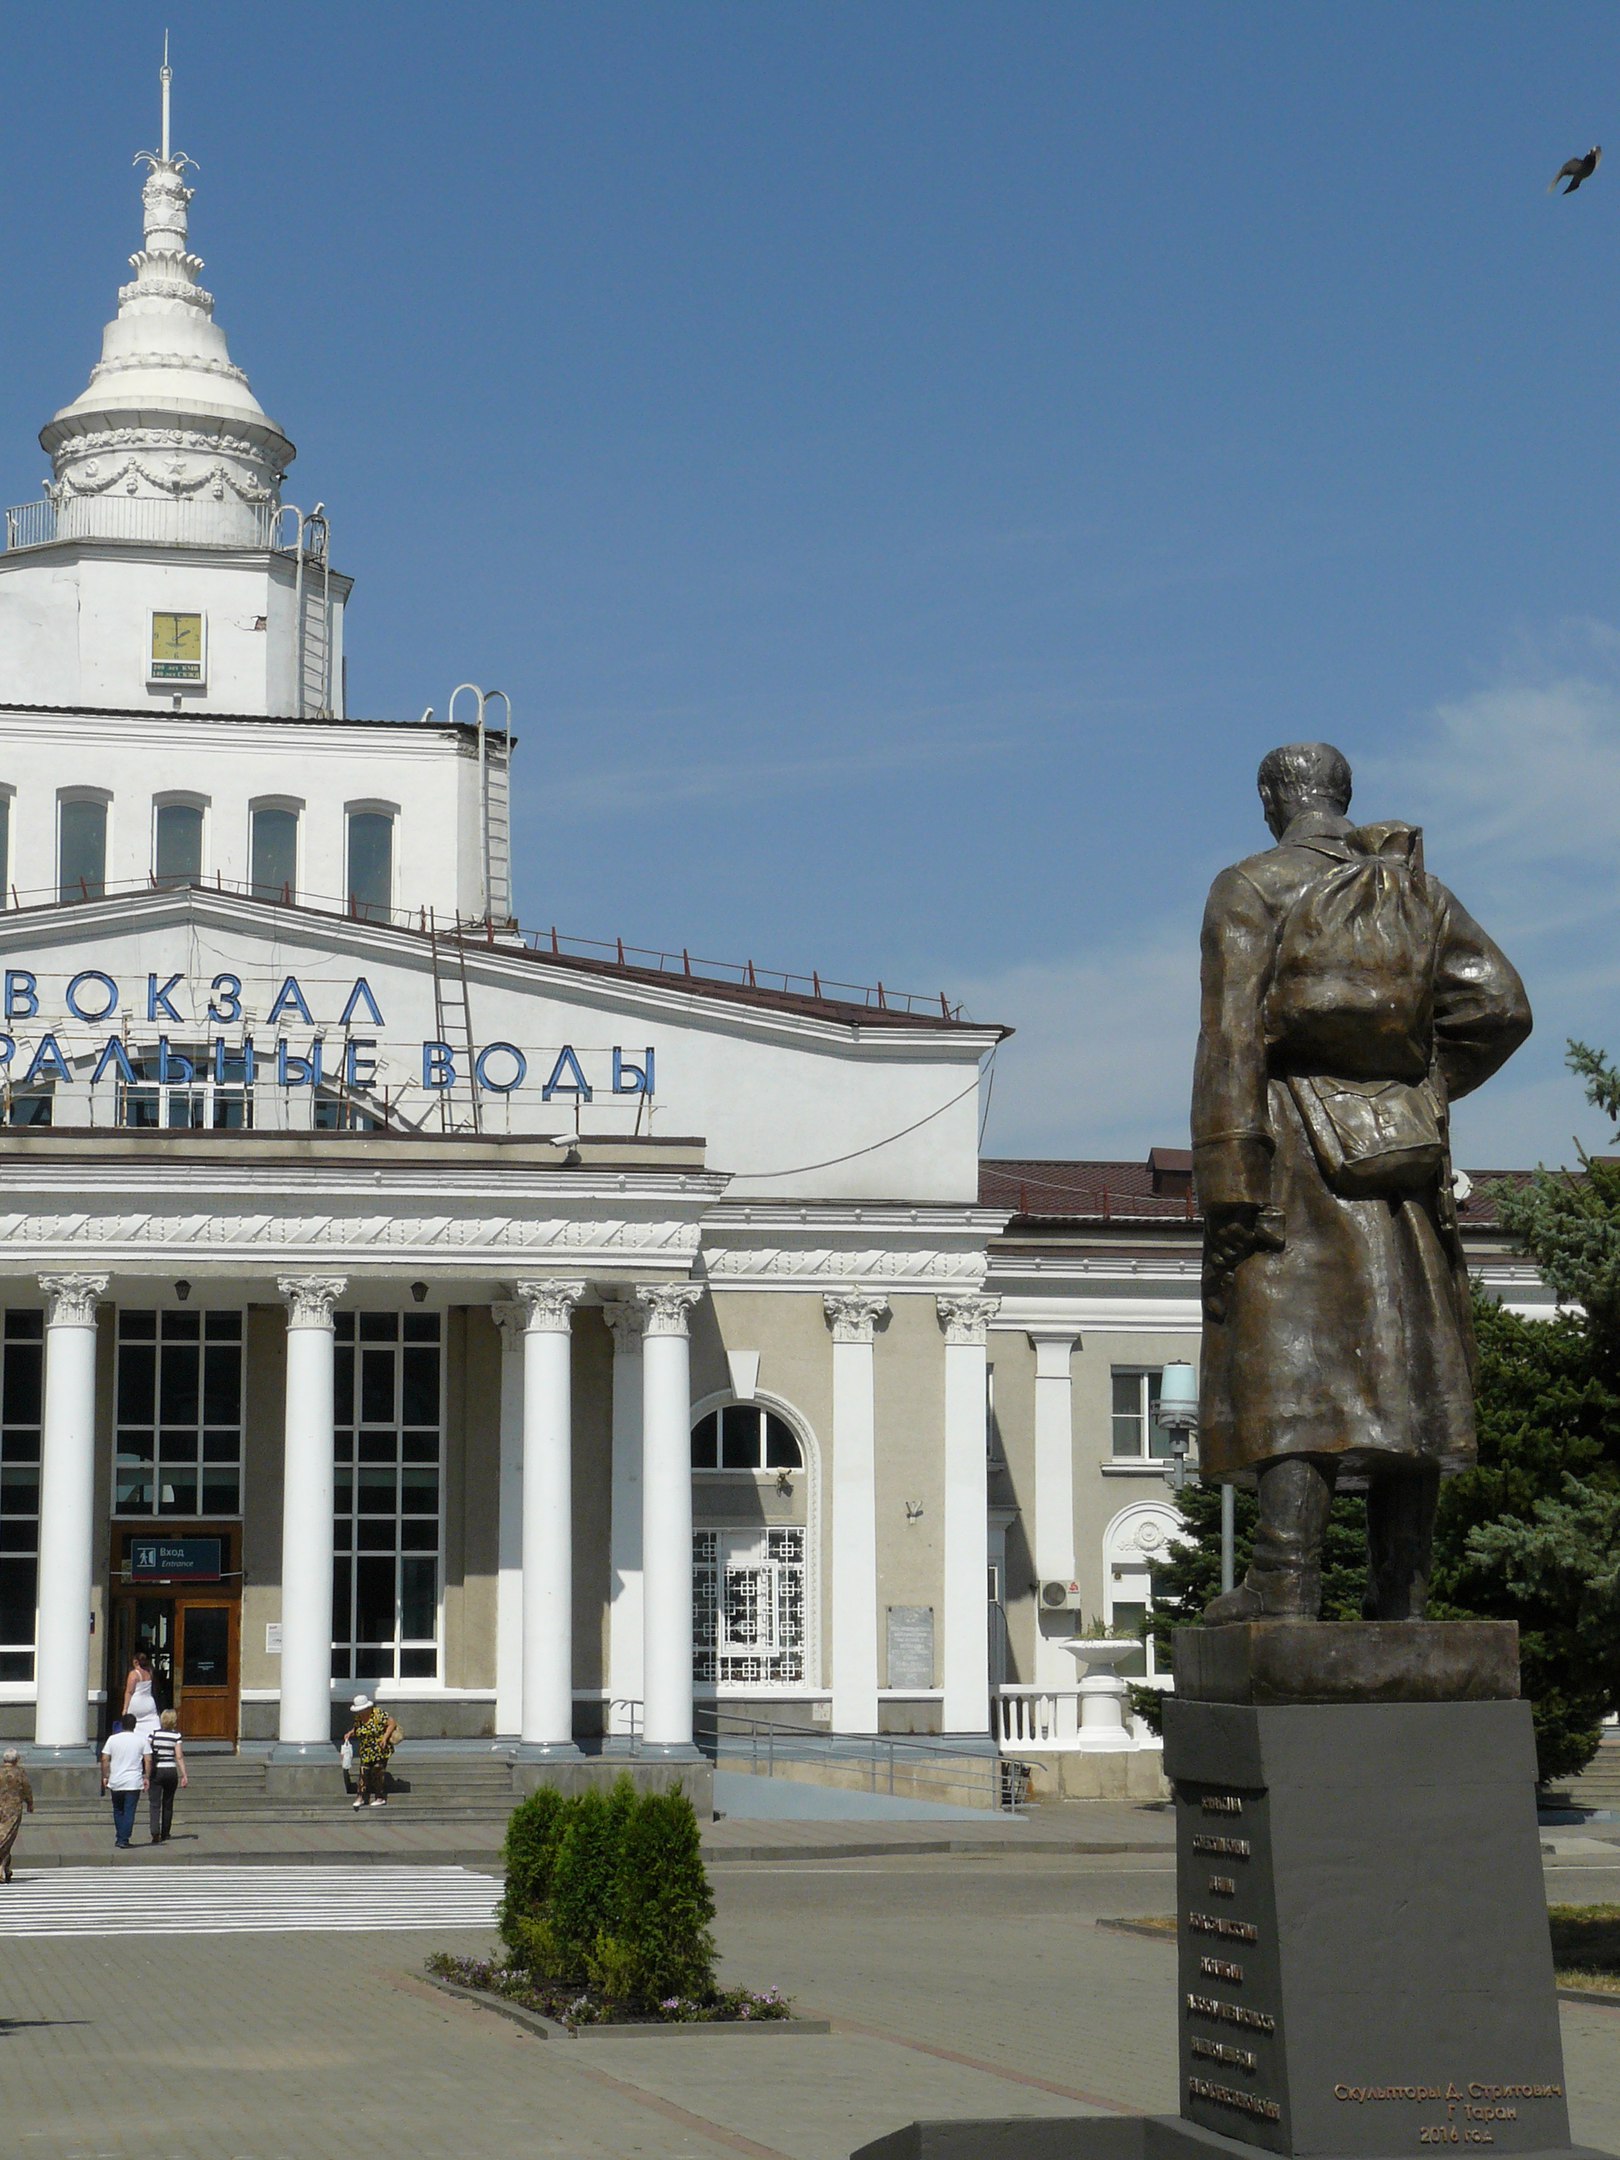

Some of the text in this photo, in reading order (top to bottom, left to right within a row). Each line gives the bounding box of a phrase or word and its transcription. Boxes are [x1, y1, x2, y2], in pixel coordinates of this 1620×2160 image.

[4, 969, 385, 1027] ВОКЗАЛ
[422, 1040, 655, 1101] ВОДЫ
[159, 1548, 185, 1558] Вход
[161, 1560, 194, 1568] Entrance
[1334, 2083, 1441, 2104] Скульпторы
[1468, 2082, 1563, 2103] Стритович
[1464, 2104, 1517, 2125] Таран
[1420, 2126, 1494, 2144] 2016 год
